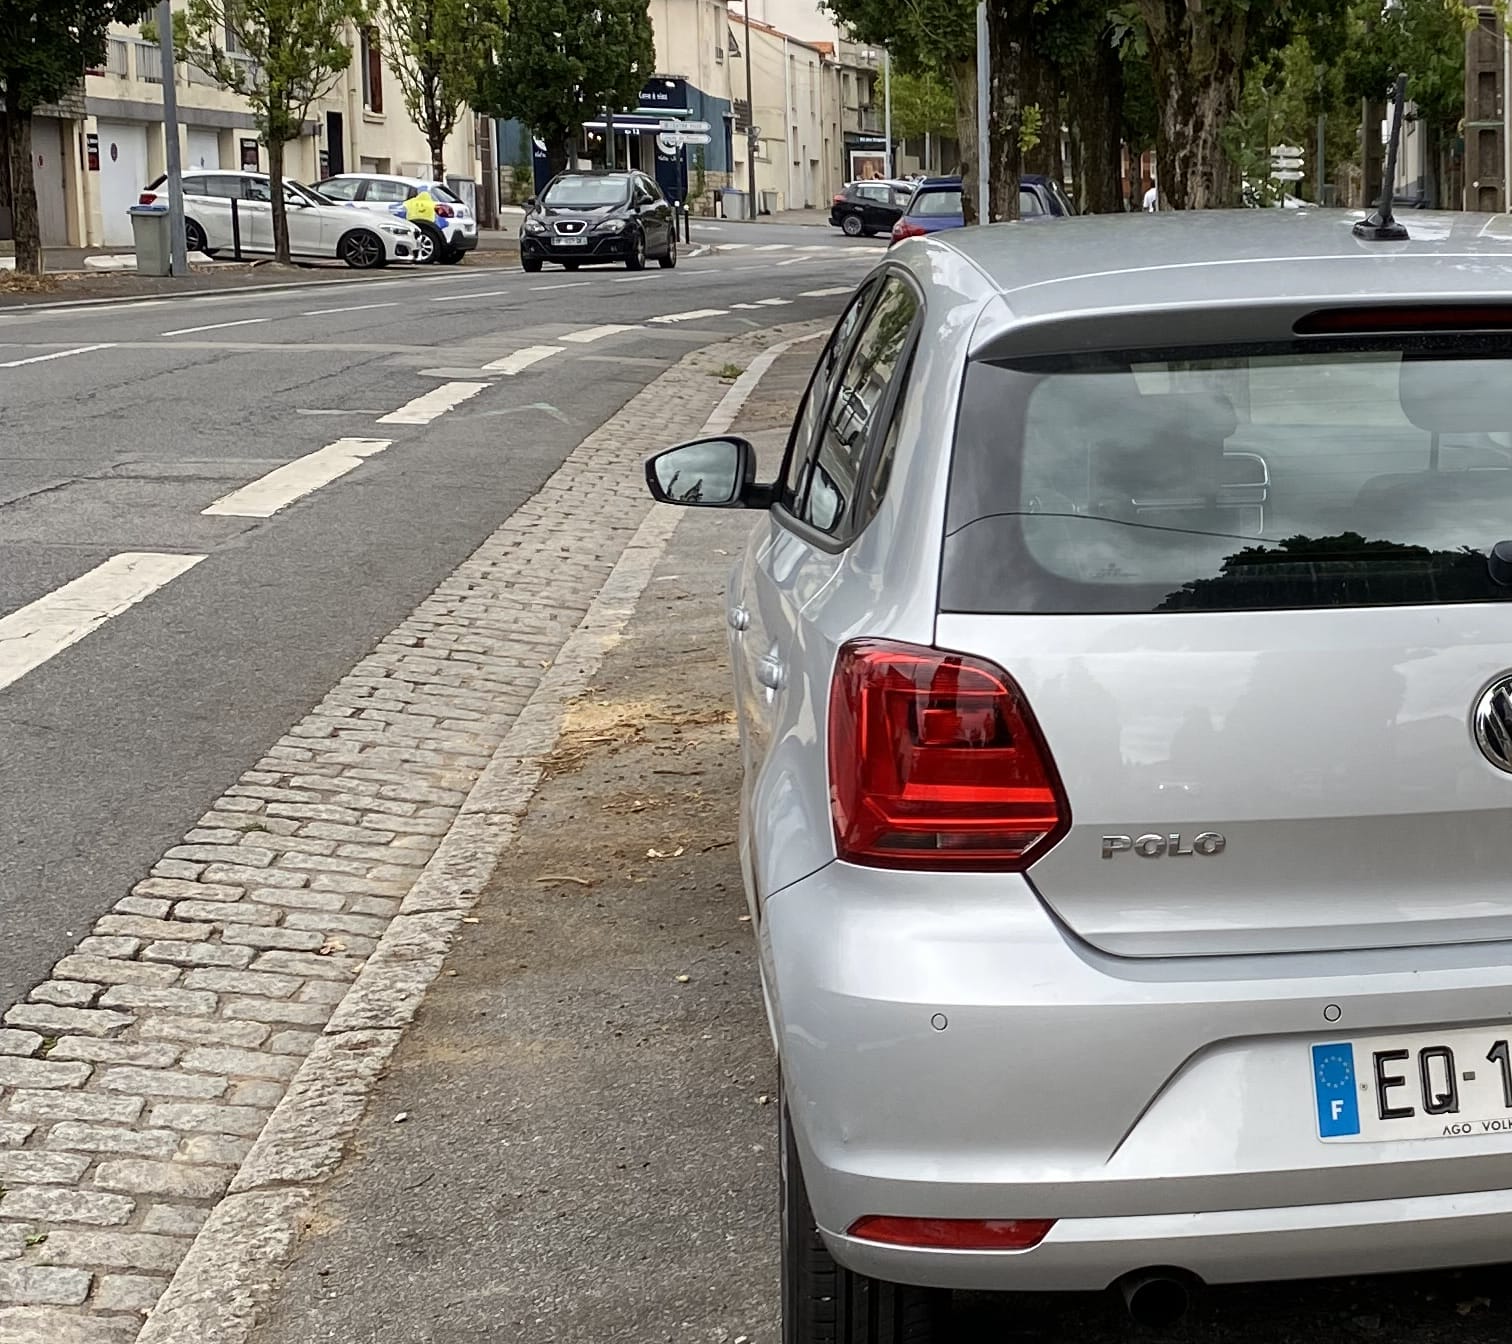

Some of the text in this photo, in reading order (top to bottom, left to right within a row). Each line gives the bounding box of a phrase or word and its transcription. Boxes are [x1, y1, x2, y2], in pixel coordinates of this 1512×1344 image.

[1101, 831, 1227, 860] POLO
[1331, 1099, 1344, 1121] F
[1442, 1123, 1472, 1136] AGO
